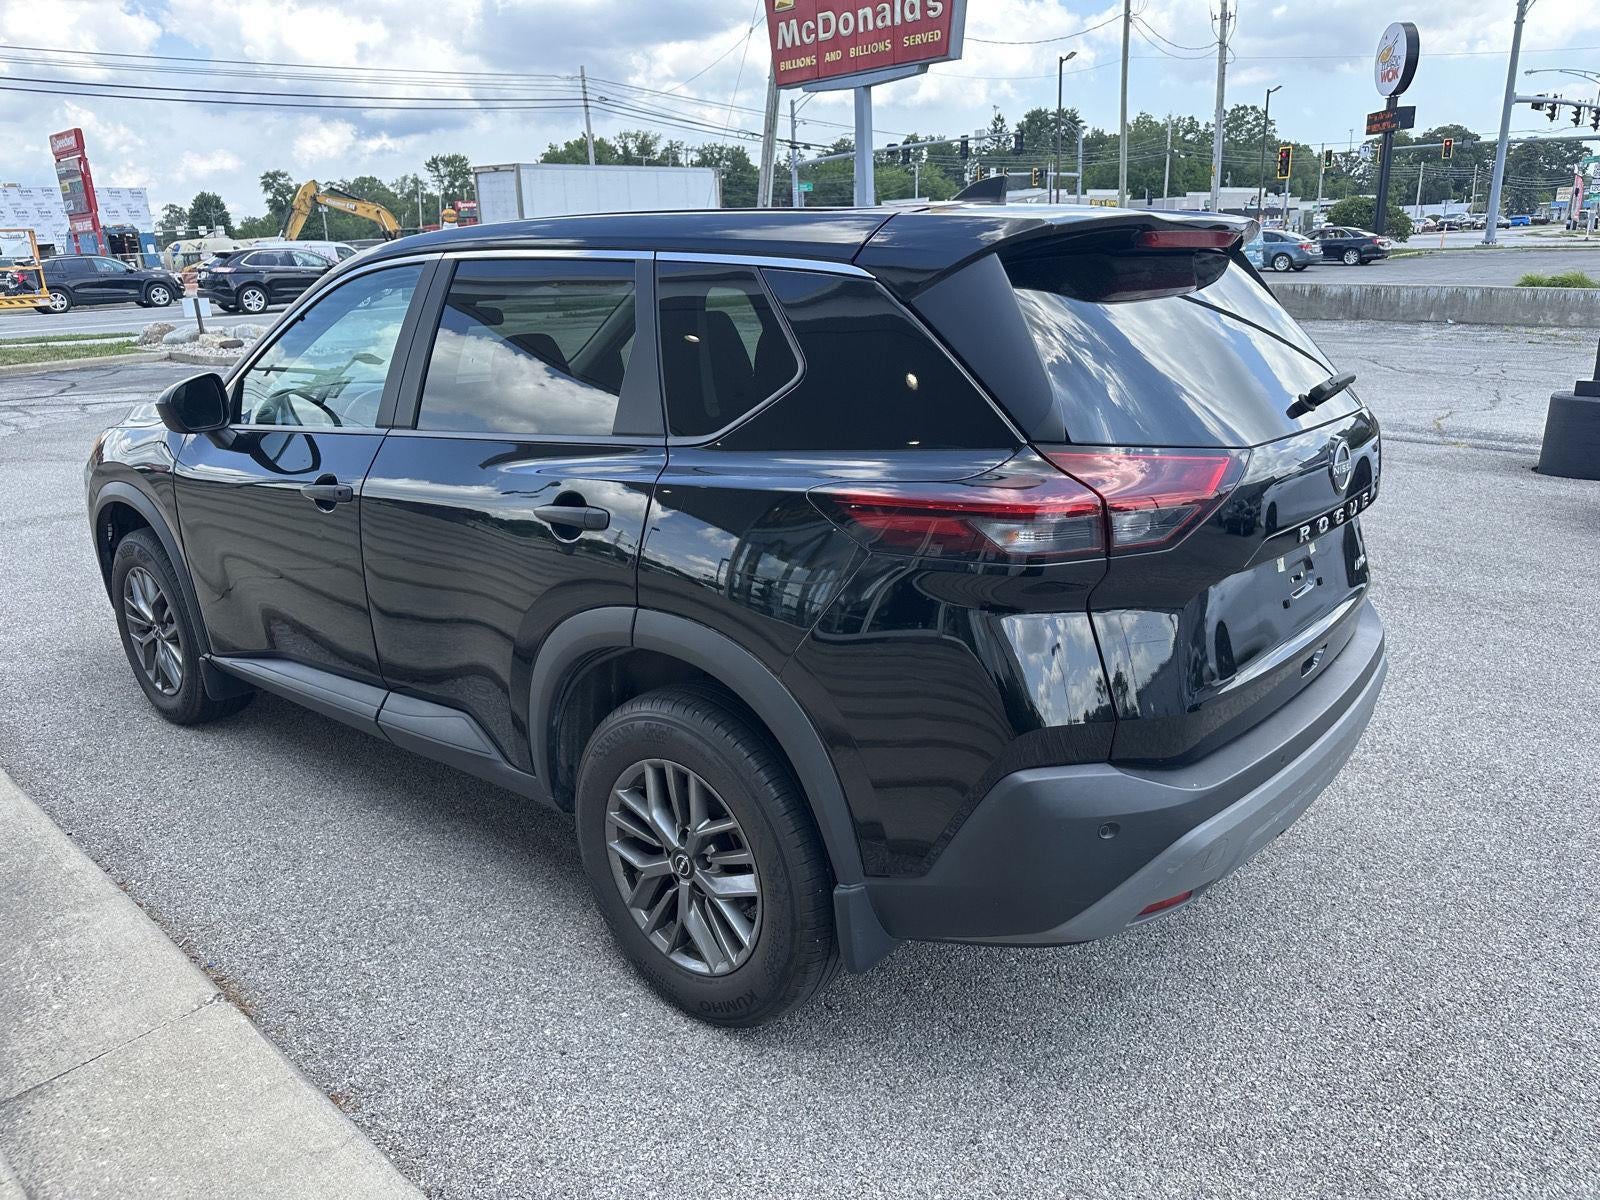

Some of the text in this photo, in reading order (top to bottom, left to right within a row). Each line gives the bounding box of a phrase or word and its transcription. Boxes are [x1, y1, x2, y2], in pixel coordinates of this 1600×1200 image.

[777, 0, 943, 50] McDonalds
[779, 30, 942, 71] BILLIONS AND BILLIONS SERVED
[1380, 67, 1399, 83] WOK
[1333, 463, 1351, 476] NISS
[1299, 492, 1369, 543] ROGUE
[699, 989, 759, 1013] KUMHO
